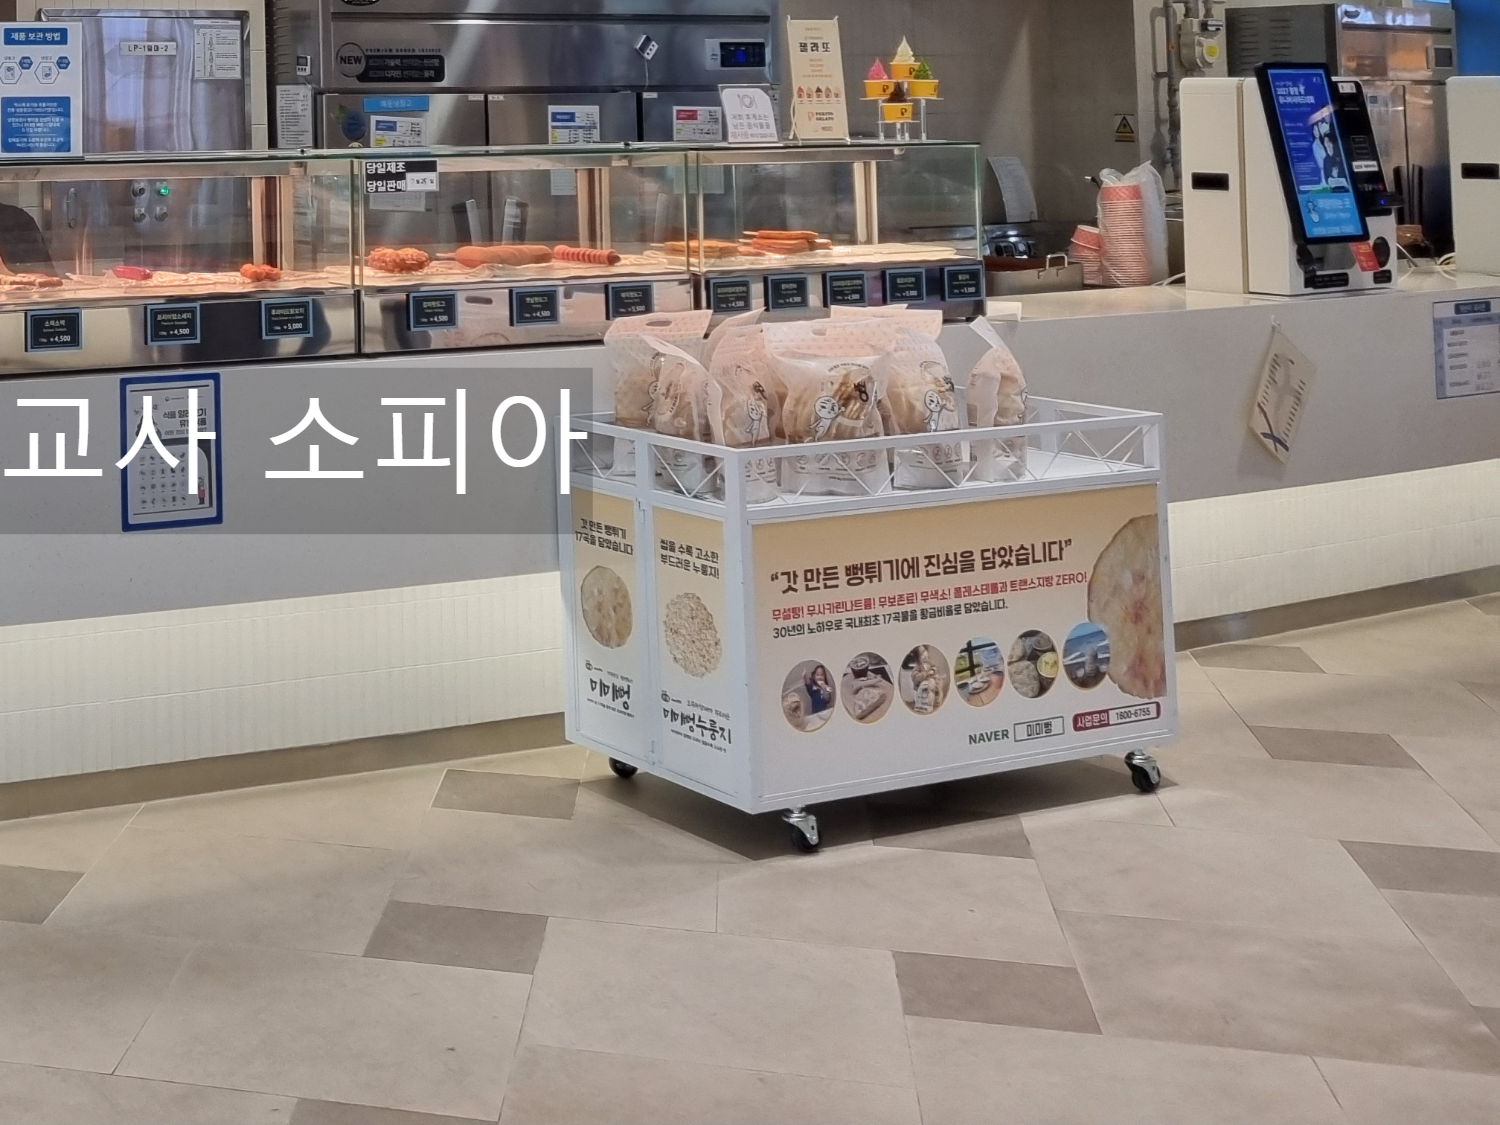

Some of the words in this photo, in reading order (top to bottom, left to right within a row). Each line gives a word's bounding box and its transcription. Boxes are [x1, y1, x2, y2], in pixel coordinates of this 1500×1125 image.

[10, 32, 26, 41] 제품
[28, 32, 43, 41] 보관
[45, 32, 61, 41] 방법
[339, 55, 363, 64] NEW
[366, 162, 406, 174] 당일제조
[366, 180, 406, 192] 당일판매
[574, 530, 597, 546] 17곡을
[597, 536, 634, 556] 담았습니다
[660, 553, 691, 572] 부드러운
[695, 547, 719, 564] 고소한
[803, 565, 839, 592] 만든
[844, 556, 920, 588] 뻥튀기에
[923, 546, 976, 577] 진심을
[771, 605, 804, 622] 무설탕!
[806, 597, 876, 618] 무사카린나트륨!
[878, 591, 919, 610] 무보존료!
[920, 587, 952, 604] 무색소!
[953, 581, 1008, 601] 콜레스테롤과
[1009, 575, 1054, 593] 트랜스지방
[1055, 571, 1088, 586] ZERO!
[772, 622, 806, 639] 30년의
[807, 617, 843, 635] 노하우로
[845, 612, 881, 630] 국내최초
[882, 608, 918, 625] 17곡물을
[920, 603, 962, 621] 황금비율로
[1076, 713, 1108, 729] 사업문의
[1115, 707, 1151, 721] 1600-6755
[968, 728, 1010, 746] NAVER
[1025, 721, 1054, 738] 미미뻥
